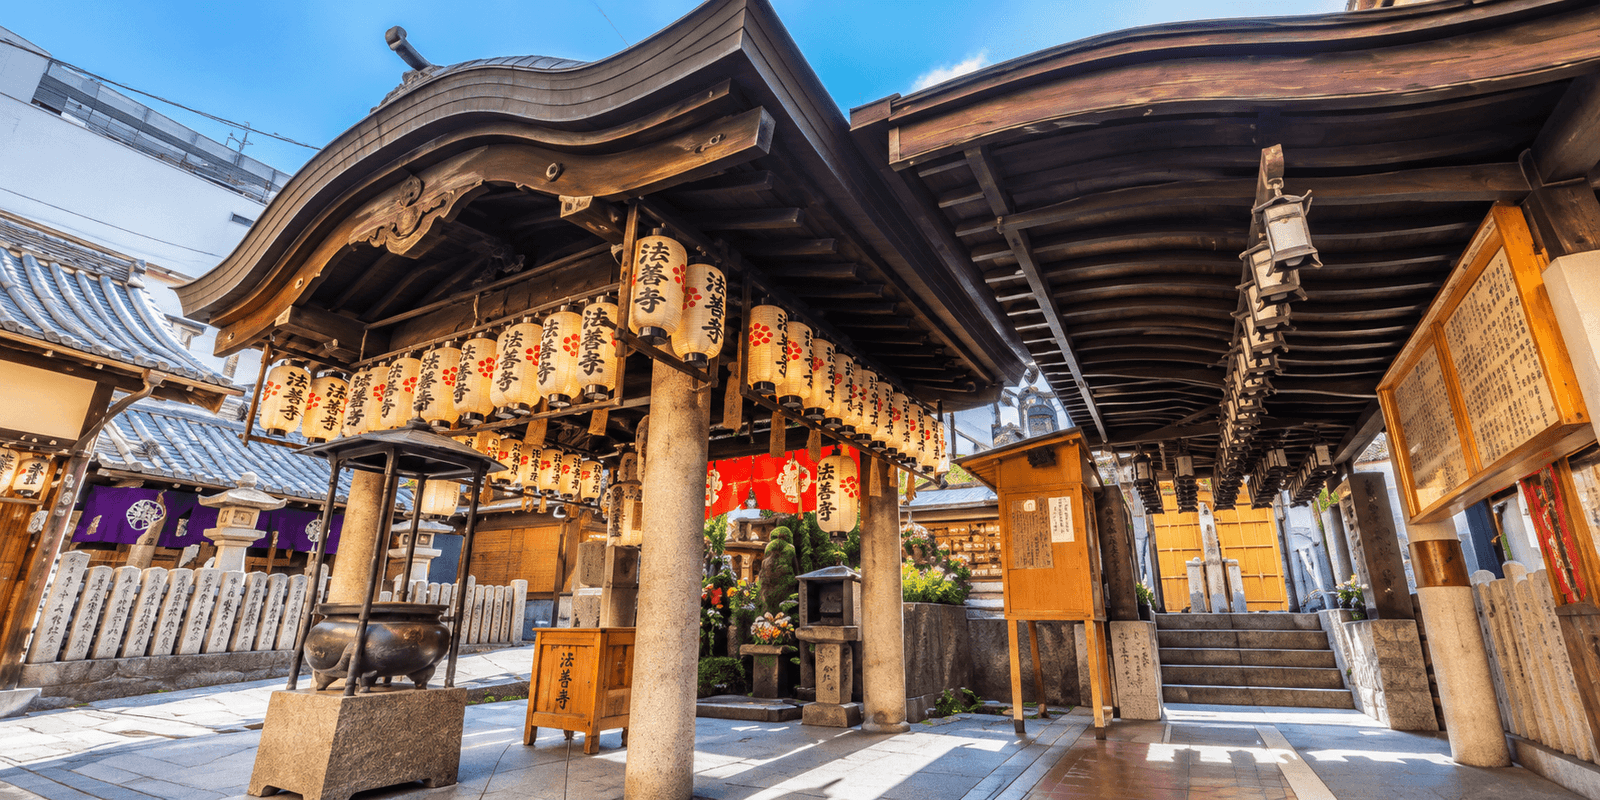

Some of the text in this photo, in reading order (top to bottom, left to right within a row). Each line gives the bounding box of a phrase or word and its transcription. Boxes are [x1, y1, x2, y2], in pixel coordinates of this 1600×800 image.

[634, 241, 670, 314] 法善寺
[702, 271, 726, 345] 法善寺
[496, 330, 524, 393] 法善寺
[537, 319, 559, 386] 法善寺
[578, 307, 608, 376] 法善寺
[280, 371, 308, 421] 法善寺
[382, 363, 404, 418] 法善寺
[414, 352, 440, 411] 法善寺
[454, 344, 477, 404] 法善寺
[321, 382, 348, 431] 法善寺
[816, 463, 838, 522] 法善寺
[555, 652, 575, 710] 法善寺
